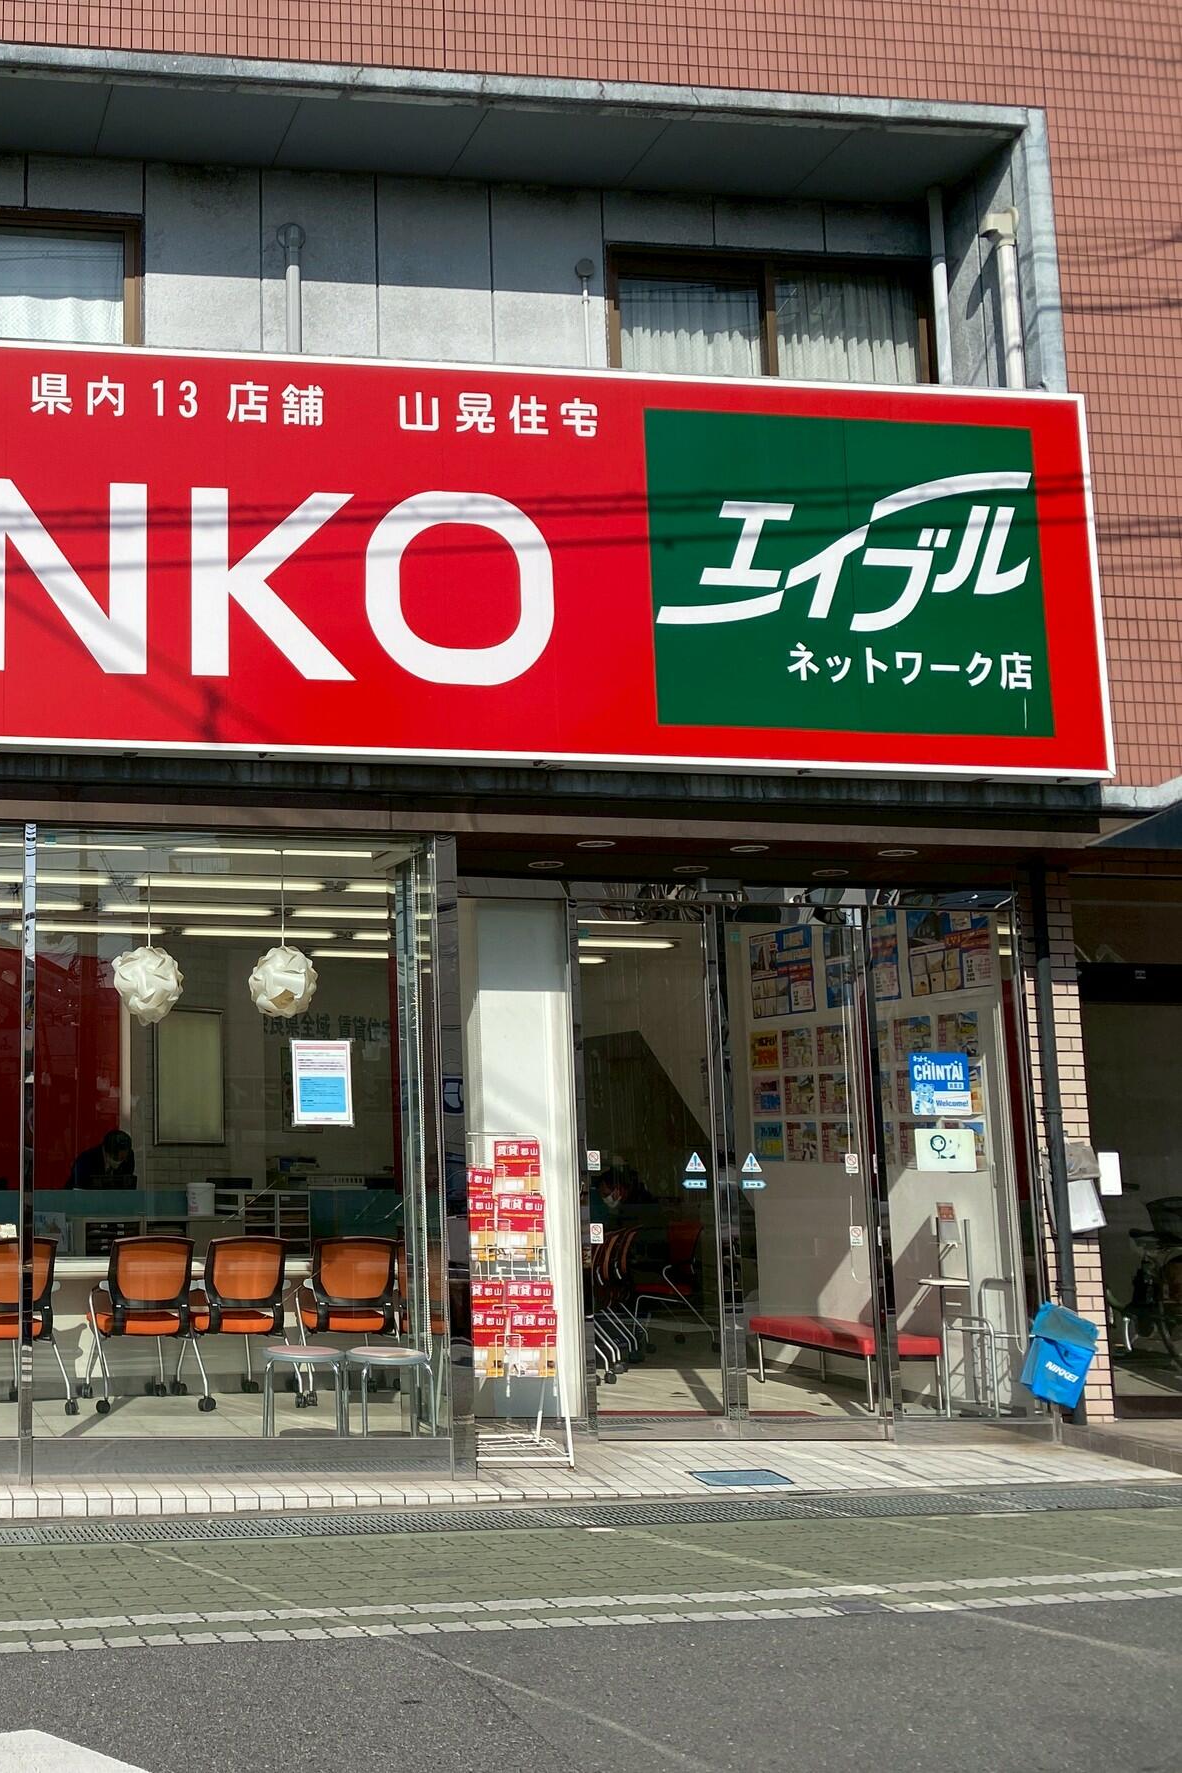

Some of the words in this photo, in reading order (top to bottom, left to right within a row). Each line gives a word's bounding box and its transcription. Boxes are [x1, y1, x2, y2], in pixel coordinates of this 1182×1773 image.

[398, 391, 600, 438] 山晃住宅
[656, 471, 1032, 632] エイブル
[787, 641, 1033, 690] ネットワーク店
[913, 1060, 964, 1081] CHINTAI
[1045, 1360, 1080, 1383] NIKKEI
